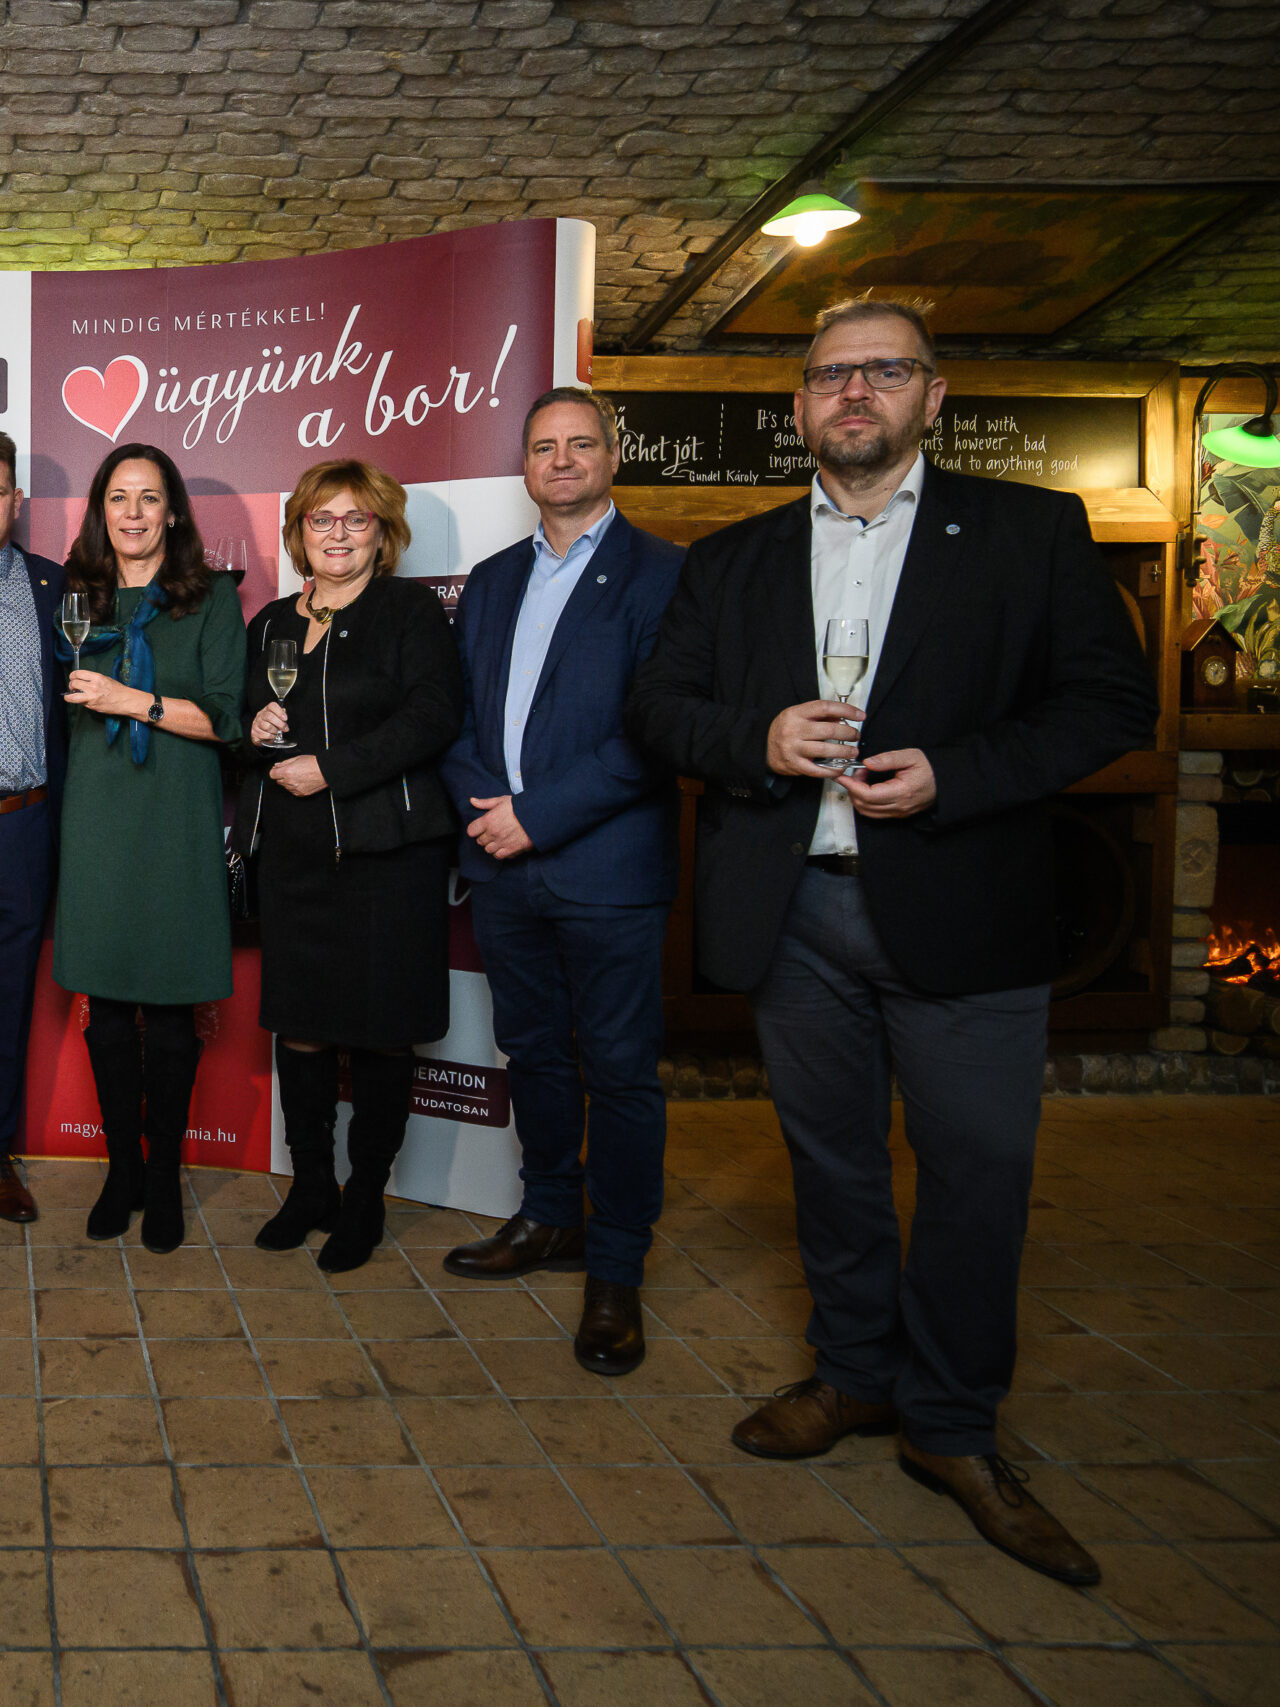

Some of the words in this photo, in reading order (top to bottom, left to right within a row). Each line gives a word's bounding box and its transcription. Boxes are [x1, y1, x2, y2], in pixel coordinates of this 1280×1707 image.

[72, 316, 160, 335] MINDIG
[174, 302, 325, 332] MÉRTÉKKEL!
[154, 304, 372, 450] ügyünk
[297, 407, 345, 448] a
[365, 324, 518, 436] bor!
[757, 409, 778, 430] It's
[954, 413, 978, 433] bad
[985, 416, 1020, 434] with
[621, 433, 671, 464] lehet
[1024, 434, 1047, 453] bad
[689, 470, 721, 483] Gundel
[726, 469, 759, 486] Károly
[969, 454, 981, 471] to
[986, 454, 1044, 477] anything
[1051, 454, 1078, 476] good
[413, 1096, 489, 1117] TUDATOSAN
